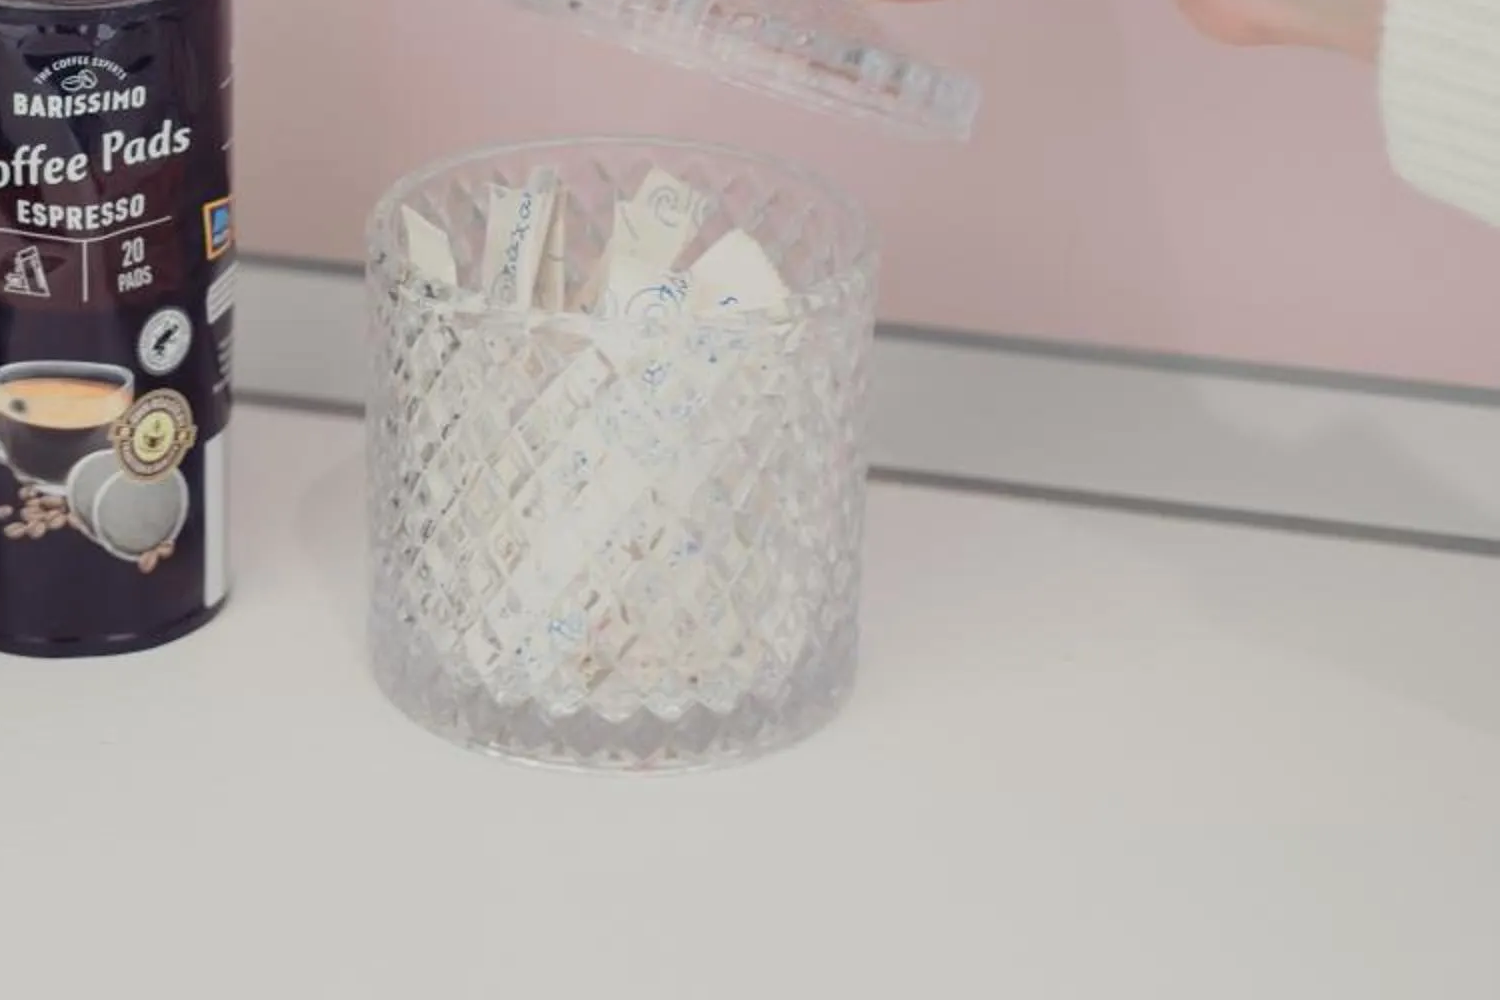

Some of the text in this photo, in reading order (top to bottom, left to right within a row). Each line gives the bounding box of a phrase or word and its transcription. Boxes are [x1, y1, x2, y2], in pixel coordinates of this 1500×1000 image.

[33, 56, 128, 85] THE COFFEE EXPERTS
[13, 86, 147, 119] BARISSIMO
[103, 119, 192, 172] Pads
[16, 193, 146, 231] ESPRESSO
[121, 236, 146, 268] 20
[117, 265, 154, 293] PADS
